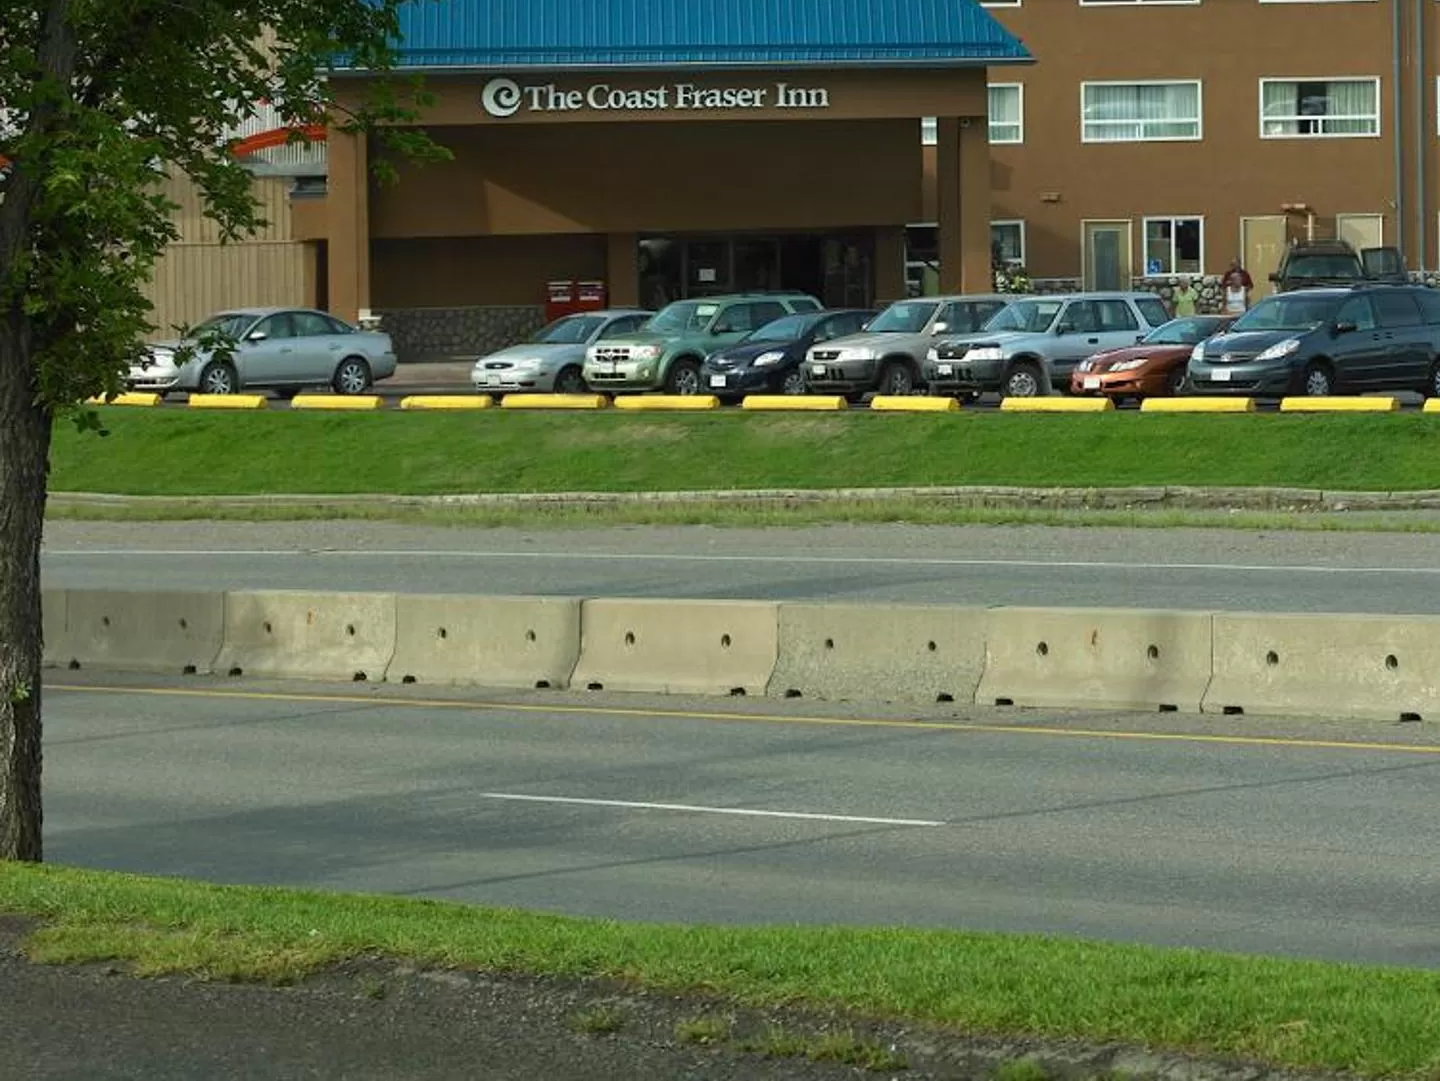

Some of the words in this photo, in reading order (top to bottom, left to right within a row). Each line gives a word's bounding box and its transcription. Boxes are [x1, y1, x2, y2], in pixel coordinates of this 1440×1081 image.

[523, 83, 584, 111] The
[586, 83, 669, 110] Coast
[673, 82, 768, 109] Fraser
[774, 82, 831, 108] Inn
